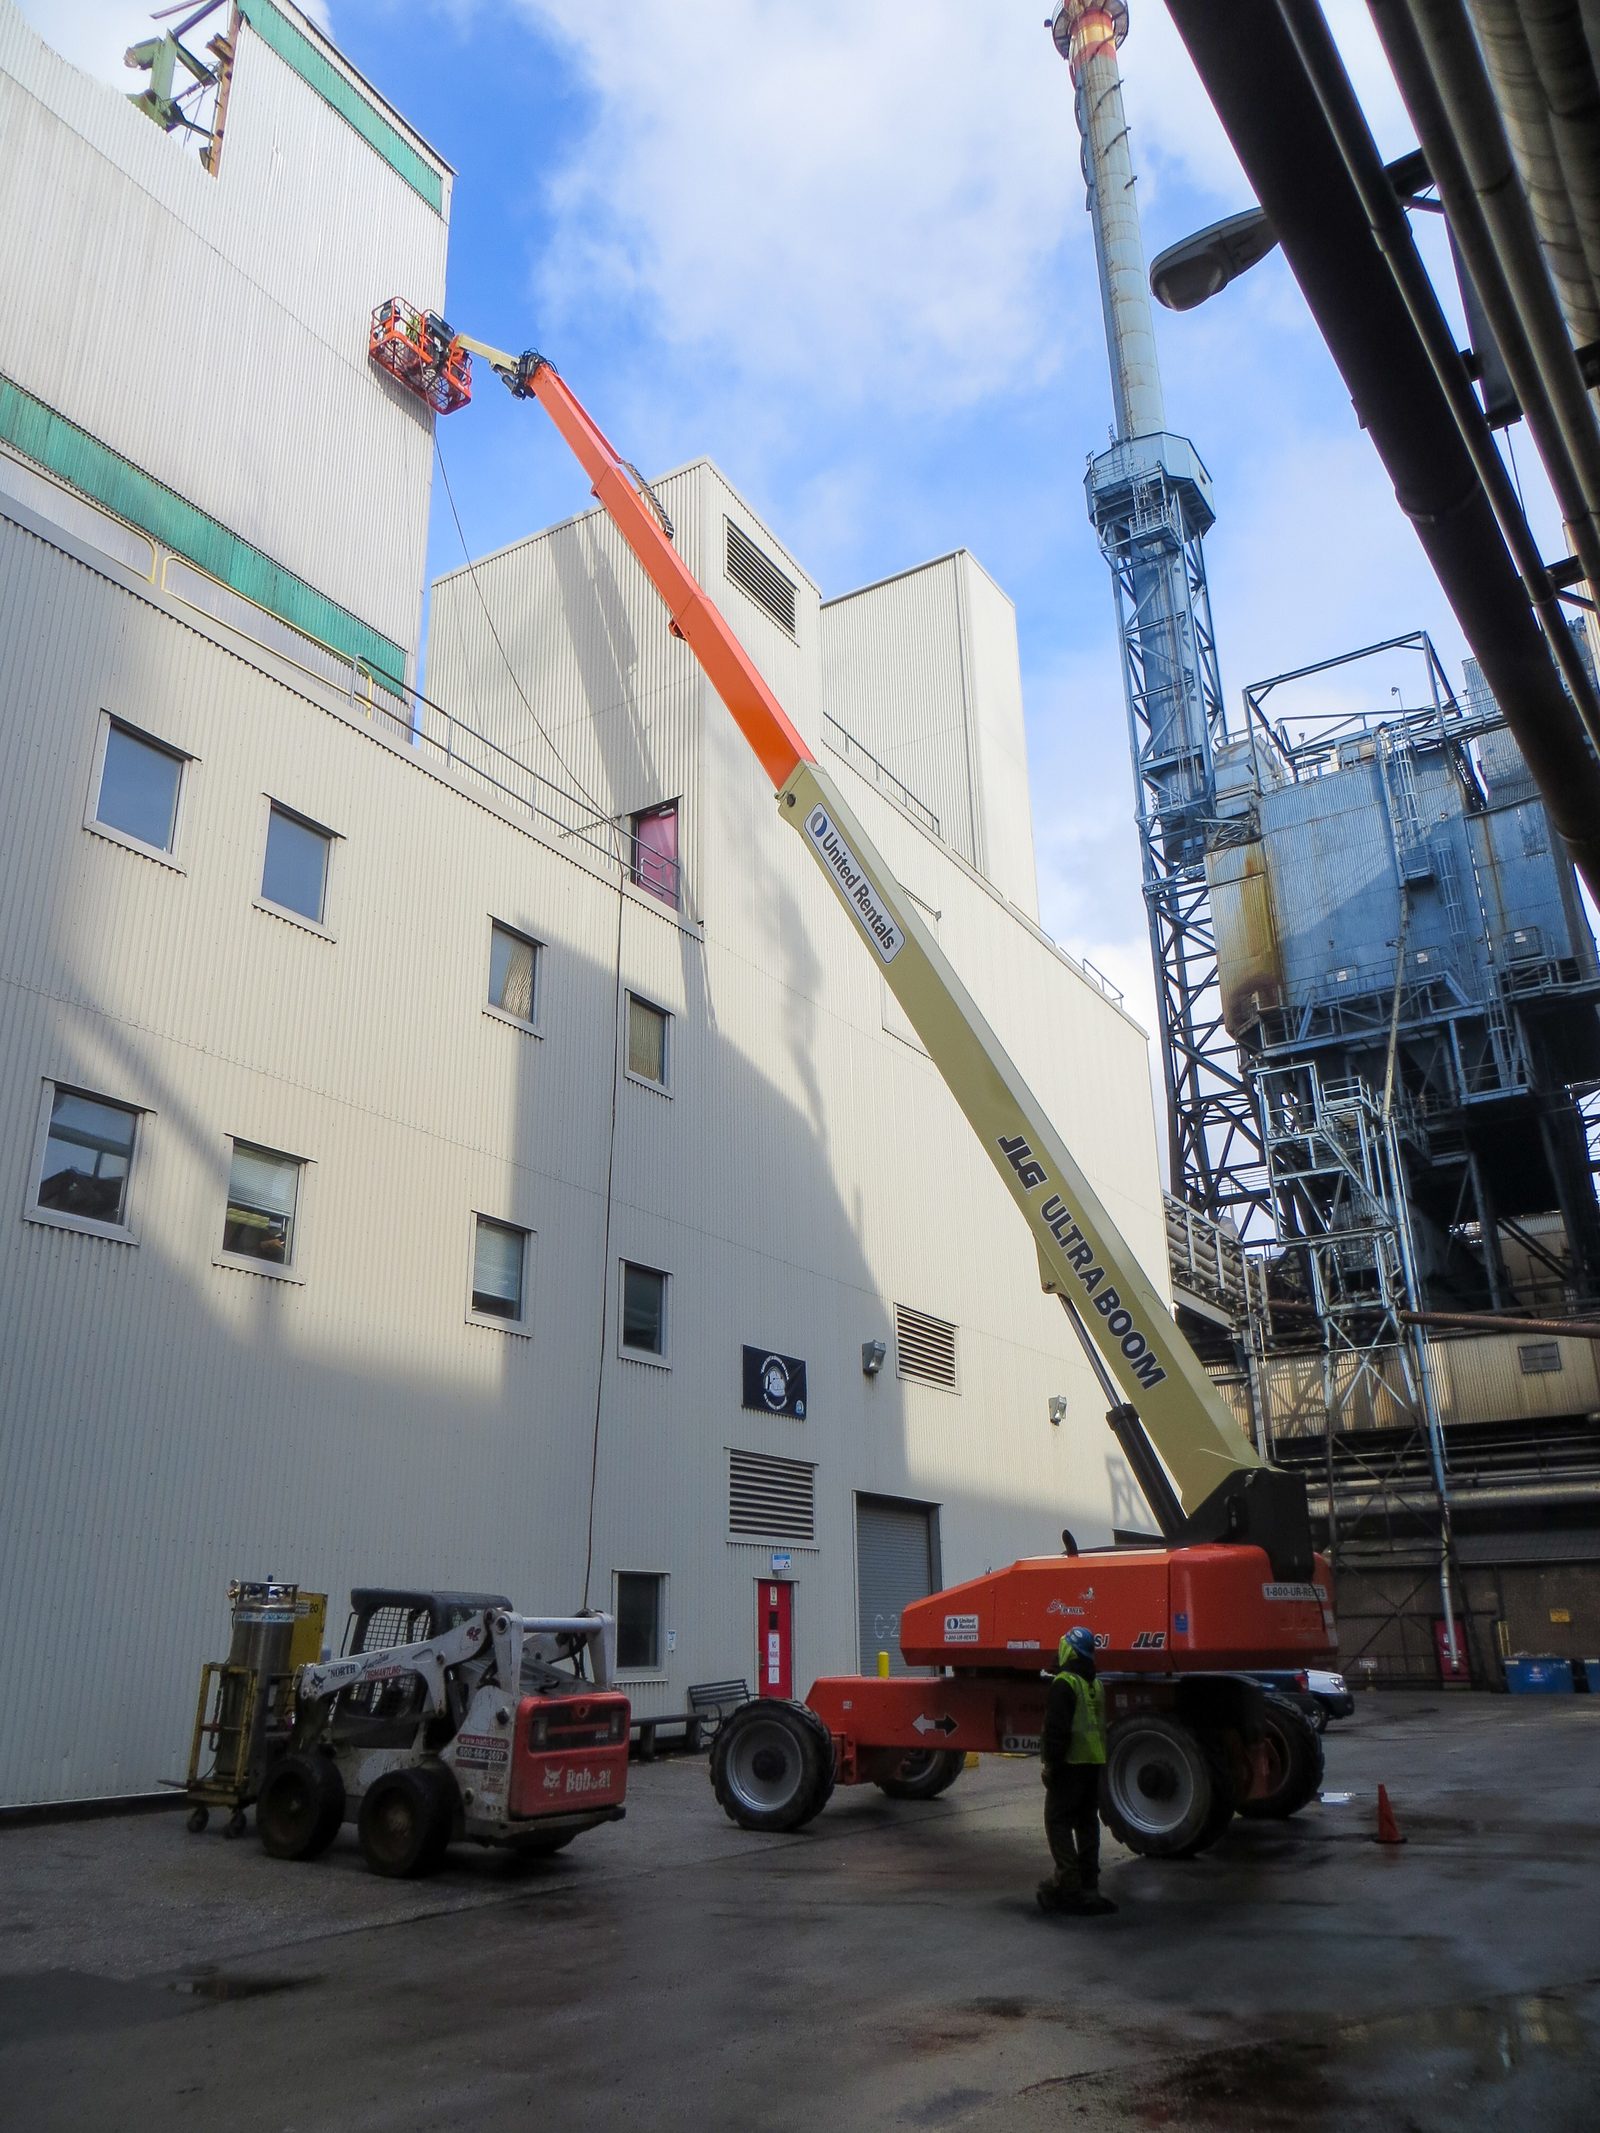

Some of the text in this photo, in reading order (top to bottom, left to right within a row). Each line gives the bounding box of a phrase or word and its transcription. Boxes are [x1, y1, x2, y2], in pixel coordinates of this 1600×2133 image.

[822, 832, 895, 950] United Rentals
[997, 1134, 1049, 1191] JLG
[1132, 1632, 1166, 1649] JLG
[330, 1664, 356, 1678] NORTH
[1021, 1738, 1041, 1750] Uni
